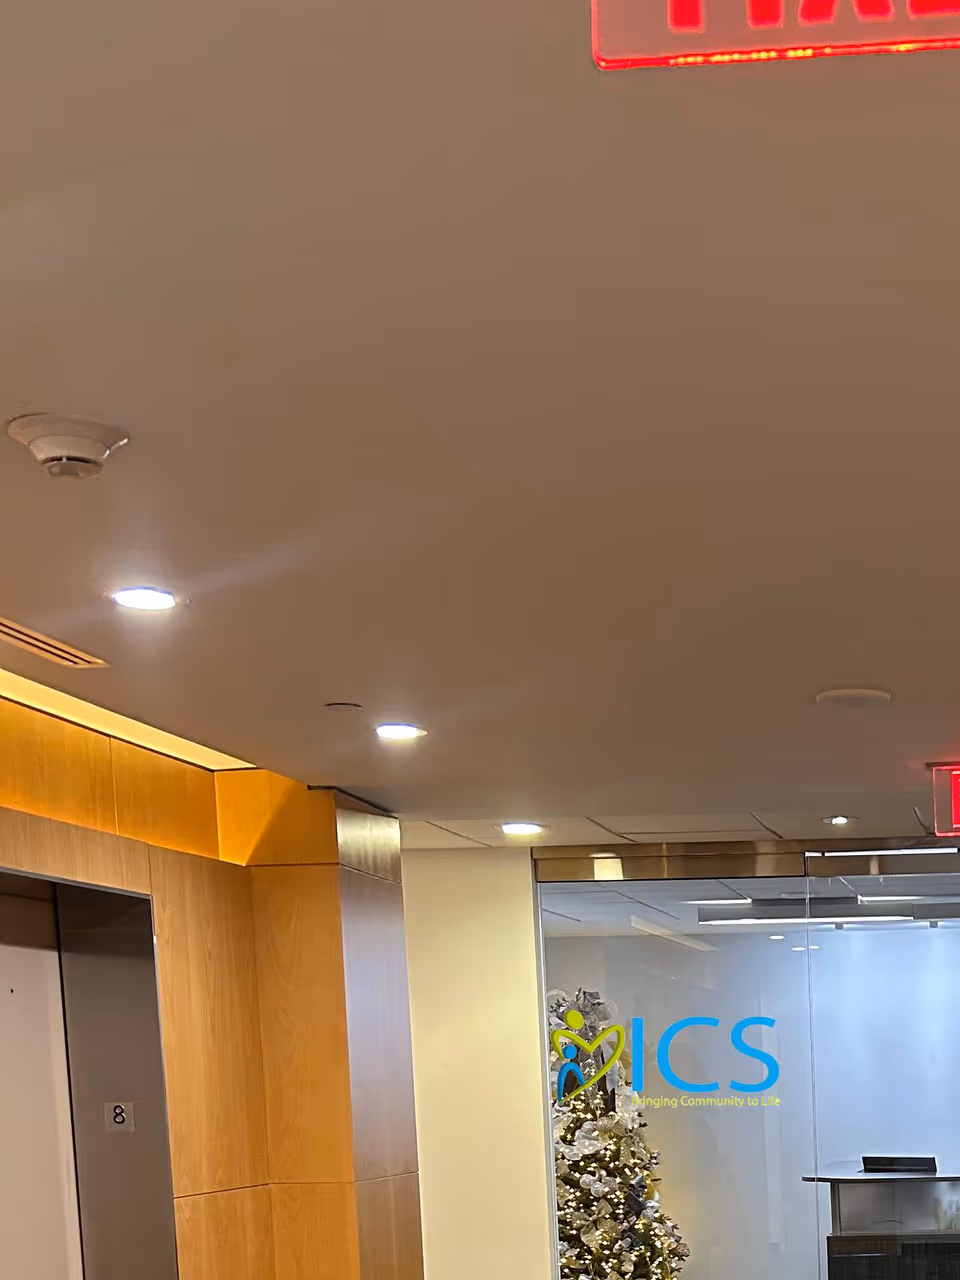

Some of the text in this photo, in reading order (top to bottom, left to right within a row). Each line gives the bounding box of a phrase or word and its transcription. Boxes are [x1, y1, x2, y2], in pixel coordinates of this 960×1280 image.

[631, 1016, 780, 1092] ICS
[631, 1095, 781, 1108] Bringing Community to Life
[113, 1104, 125, 1124] 8
